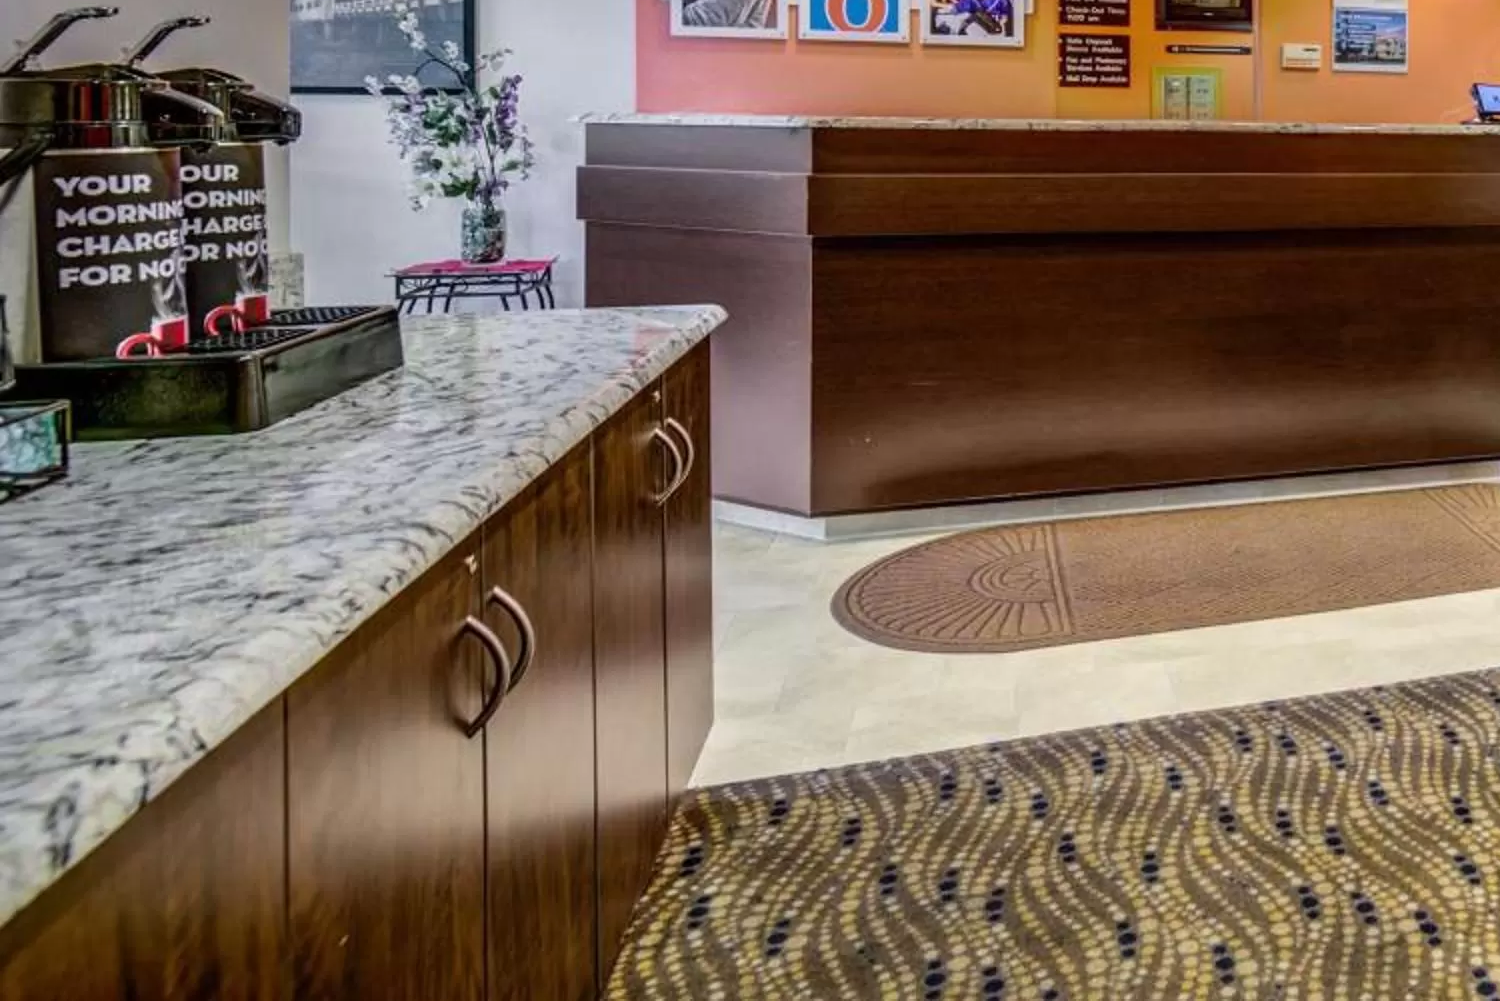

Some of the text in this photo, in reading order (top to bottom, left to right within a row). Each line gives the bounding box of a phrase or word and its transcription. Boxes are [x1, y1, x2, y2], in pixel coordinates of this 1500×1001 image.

[179, 164, 239, 183] OUR
[54, 174, 152, 198] YOUR
[183, 188, 266, 209] ORNIN
[182, 214, 268, 236] HARGE
[182, 243, 219, 262] OR
[58, 264, 132, 289] FOR
